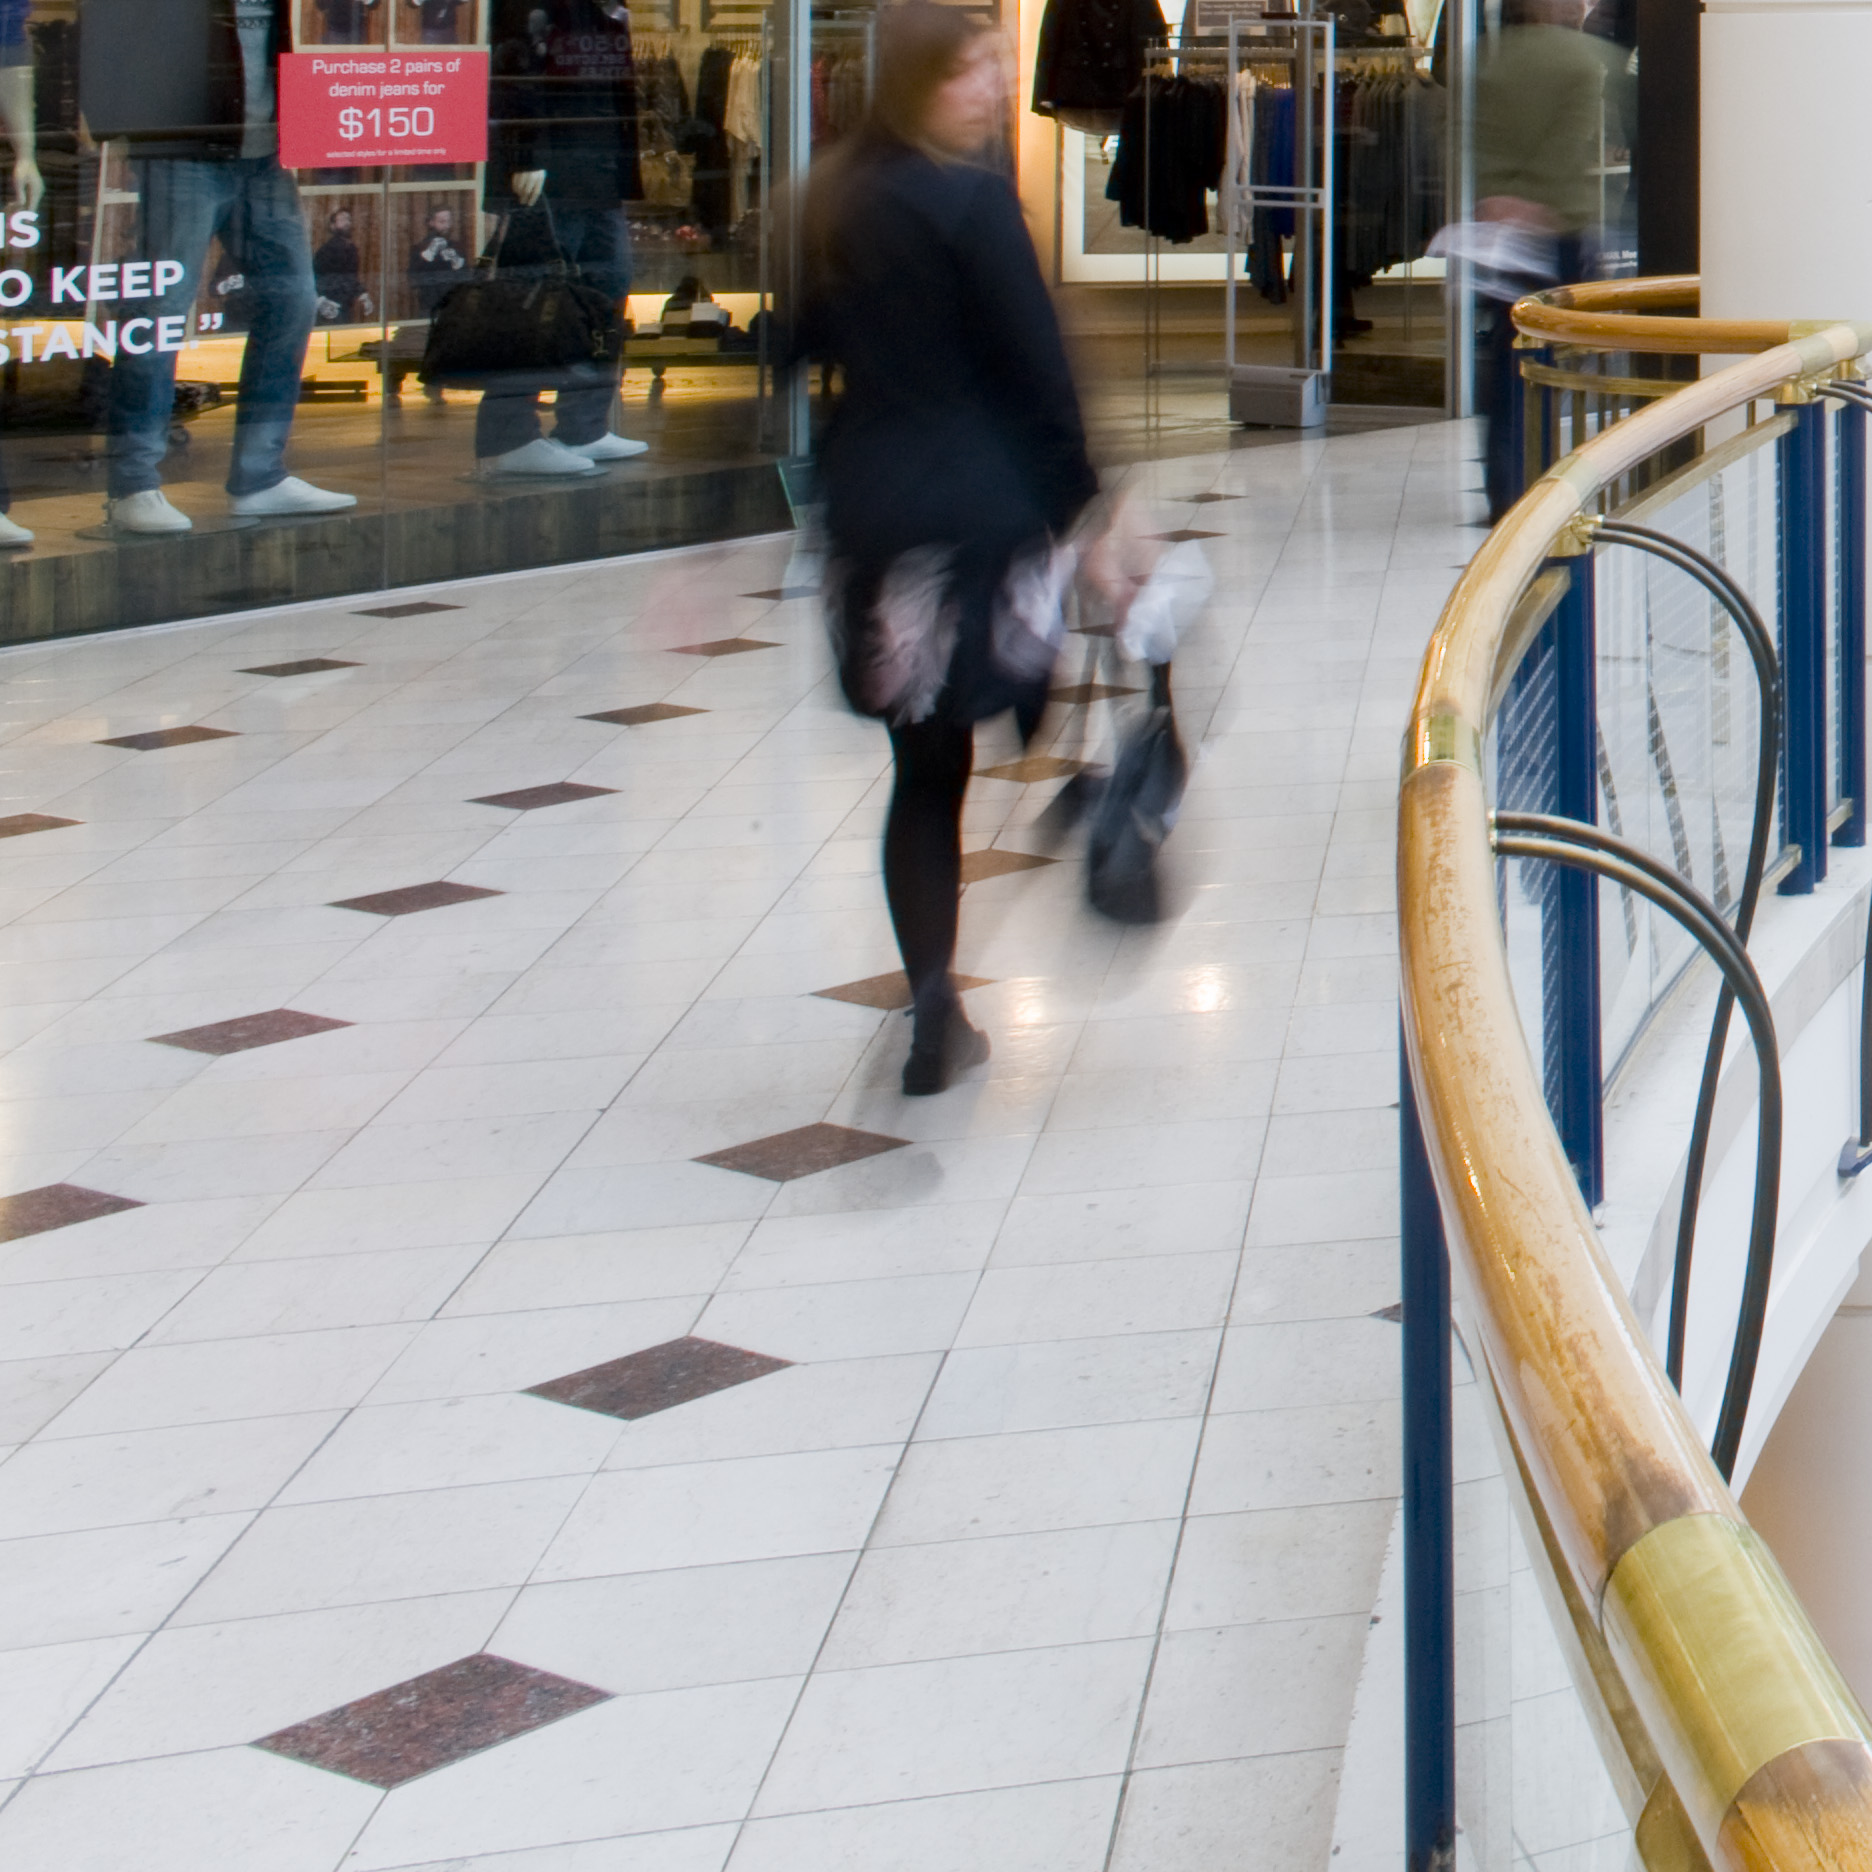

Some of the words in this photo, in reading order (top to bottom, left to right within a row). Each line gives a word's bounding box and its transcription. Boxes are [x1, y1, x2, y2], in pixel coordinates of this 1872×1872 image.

[312, 59, 386, 74] Purchase
[389, 58, 401, 73] 2
[405, 59, 443, 76] pairs
[446, 58, 461, 73] of
[329, 82, 376, 97] denim
[379, 82, 420, 99] jeans
[423, 81, 445, 95] for
[339, 106, 434, 141] $150
[51, 260, 185, 304] KEEP
